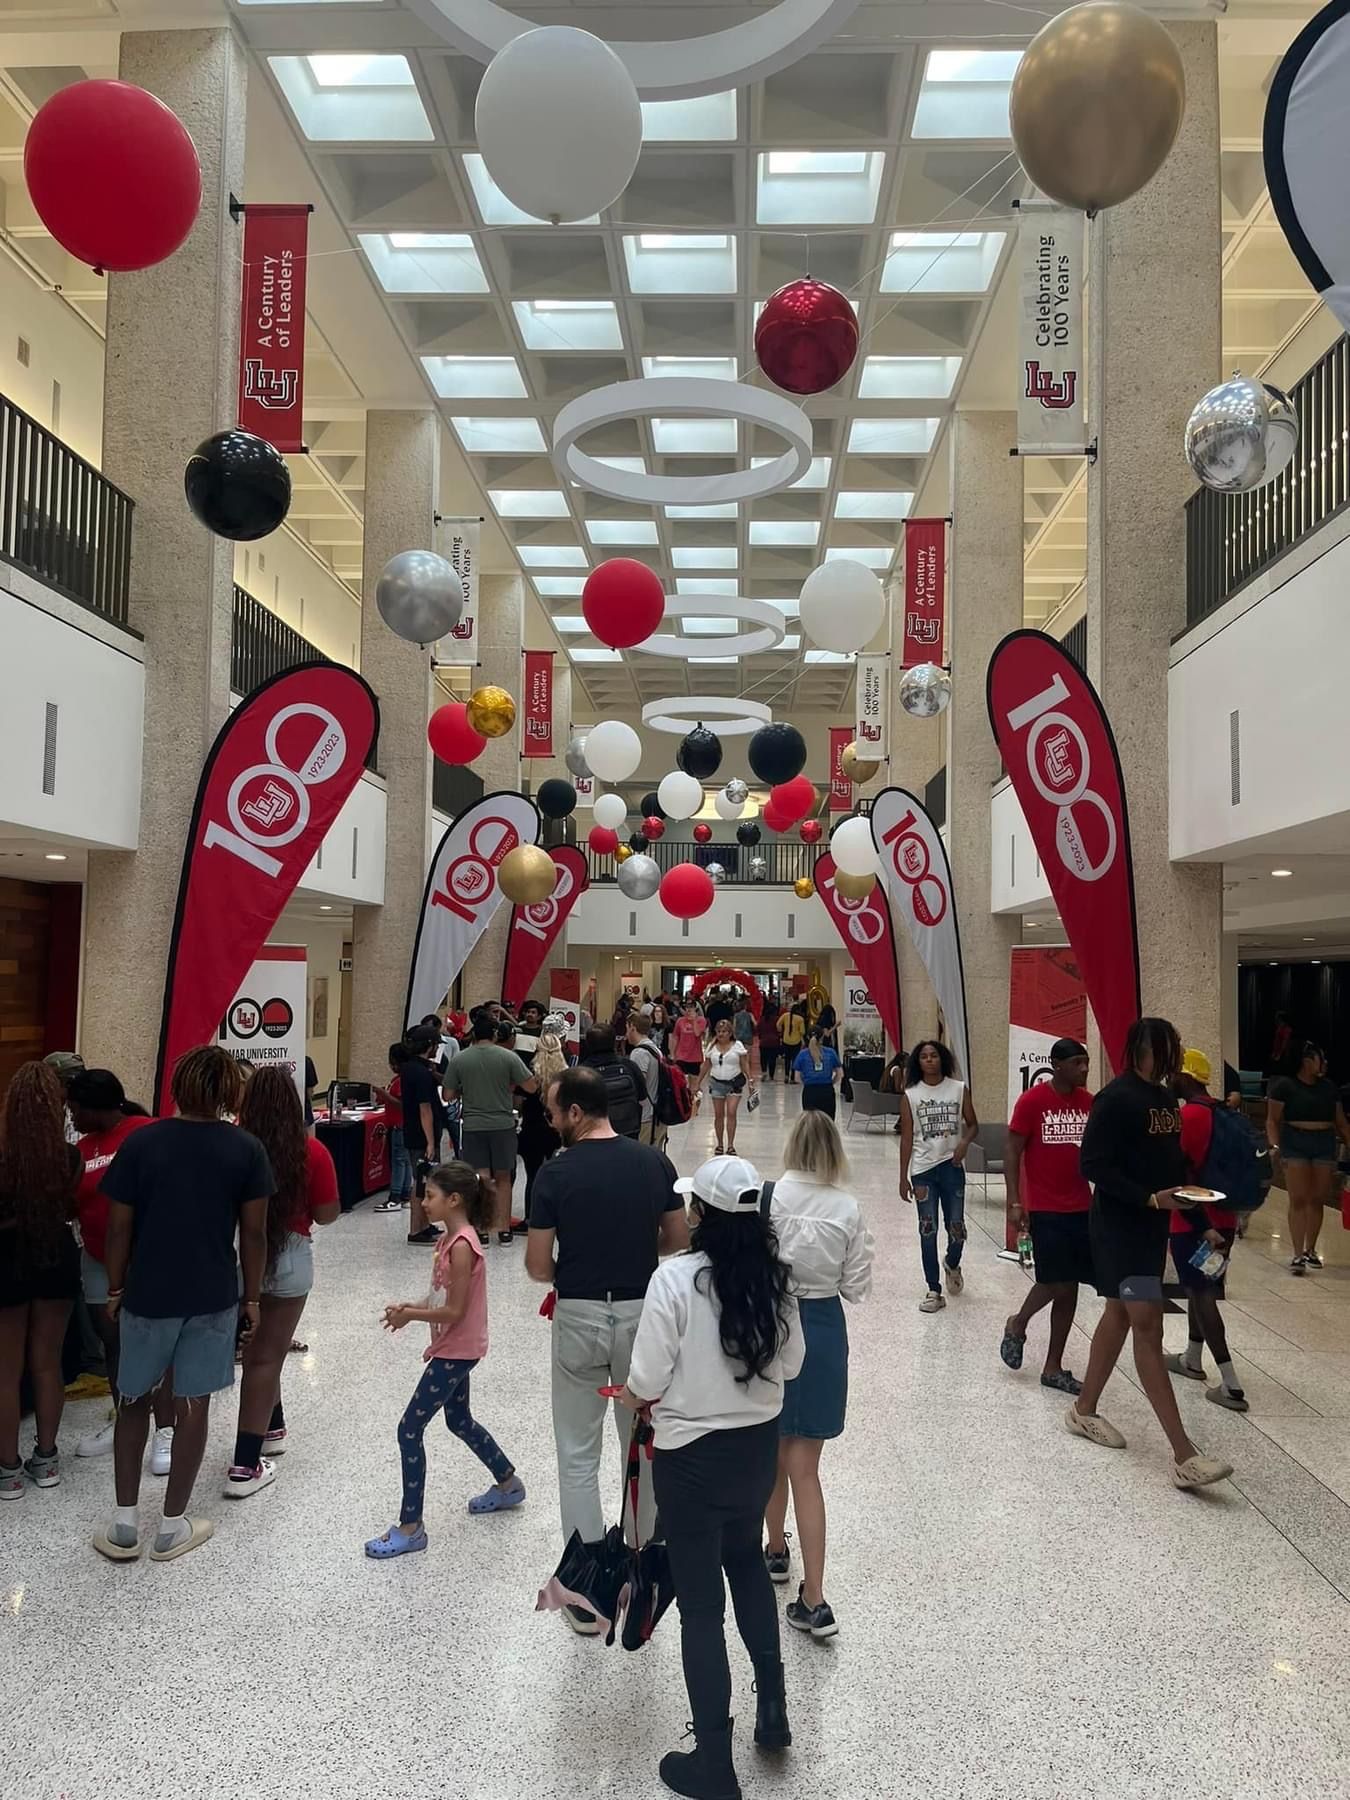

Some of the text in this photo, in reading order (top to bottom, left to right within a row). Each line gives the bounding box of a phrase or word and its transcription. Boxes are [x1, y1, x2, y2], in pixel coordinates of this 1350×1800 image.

[258, 255, 279, 348] A Century
[276, 250, 293, 348] of Leaders
[1036, 235, 1055, 347] Celebrating
[1054, 255, 1069, 347] 100 Years
[451, 536, 463, 576] rating
[461, 549, 471, 580] Years
[915, 549, 928, 606] A Century
[926, 545, 936, 606] of Leaders
[532, 672, 541, 705] Century
[540, 704, 547, 713] of
[864, 667, 873, 716] Celebrating
[307, 733, 341, 779] 1923-2023
[1060, 816, 1085, 872] 1923-2023
[229, 1047, 289, 1060] MAR UNIVERSITY
[1020, 1052, 1052, 1063] A Cent
